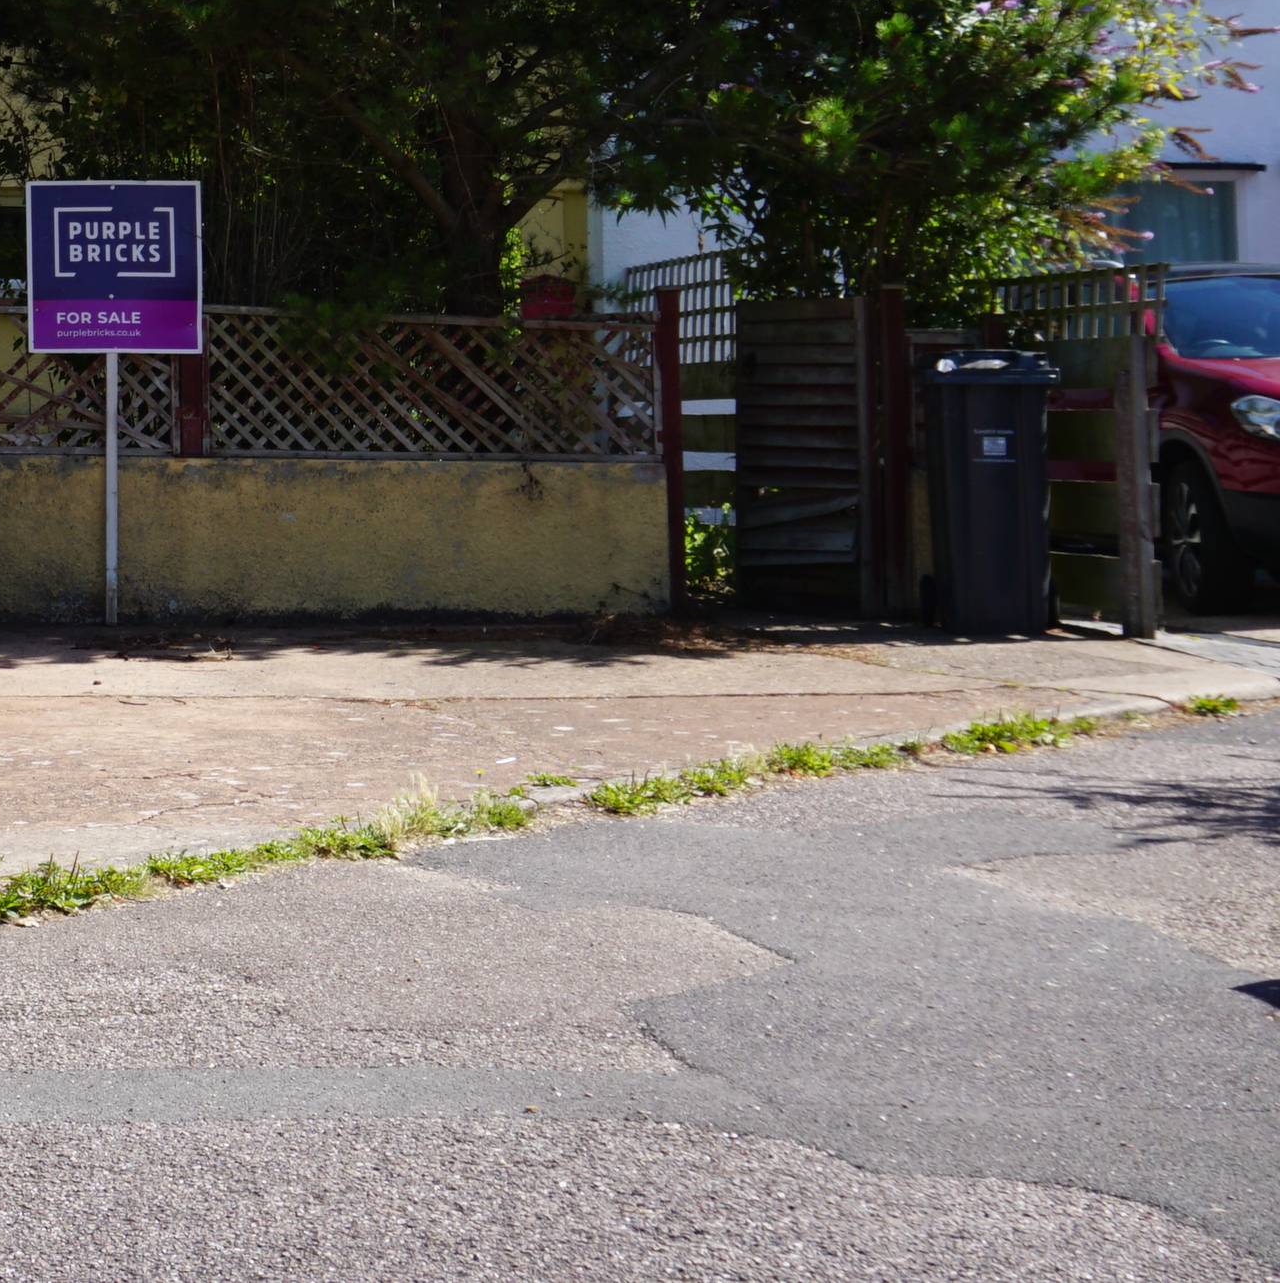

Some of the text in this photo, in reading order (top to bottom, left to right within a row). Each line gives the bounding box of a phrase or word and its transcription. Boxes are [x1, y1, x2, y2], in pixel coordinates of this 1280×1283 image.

[69, 221, 160, 240] PURPLE
[69, 244, 161, 262] BRICKS
[56, 312, 141, 324] FOR SALE
[57, 329, 141, 338] purplebricks.co.uk
